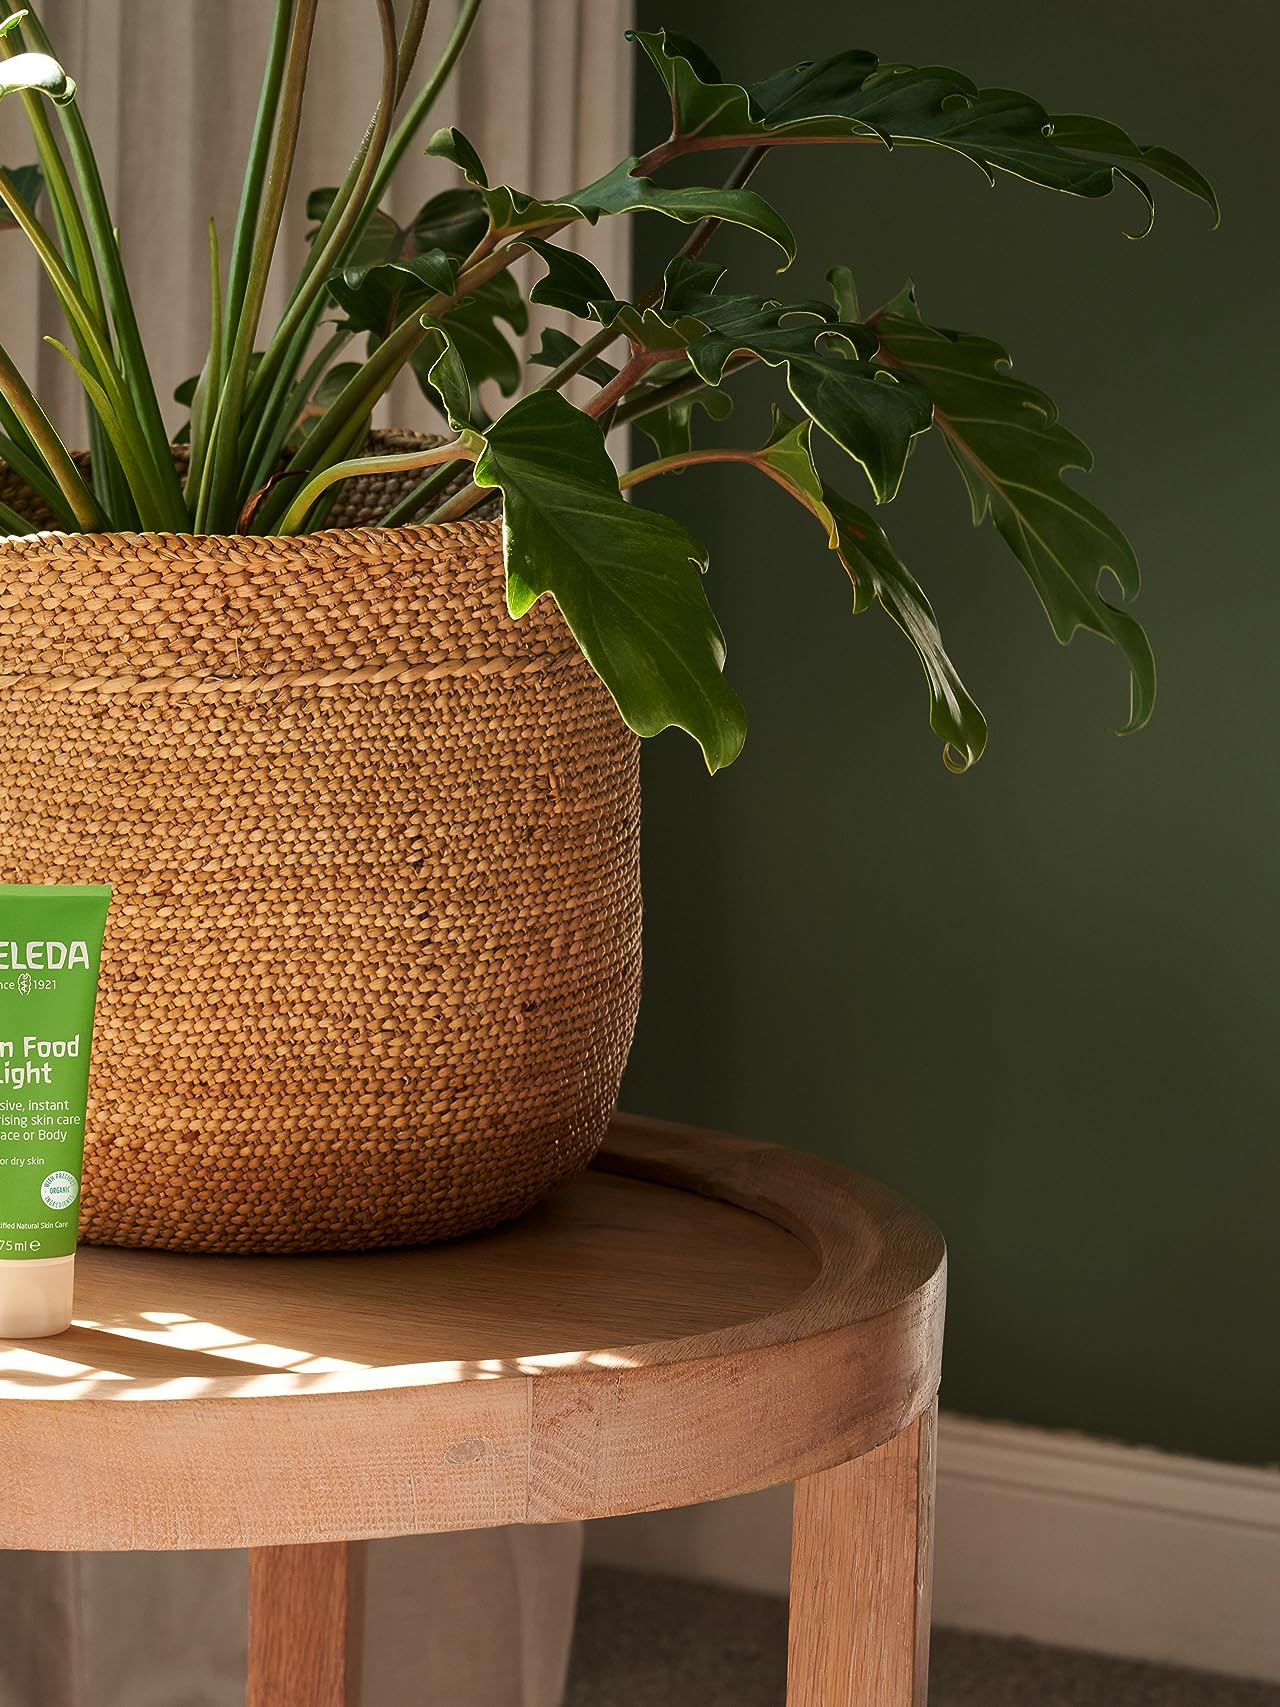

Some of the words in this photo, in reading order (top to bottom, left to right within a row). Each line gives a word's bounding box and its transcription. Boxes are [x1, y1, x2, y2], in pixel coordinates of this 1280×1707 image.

[33, 980, 56, 990] 1921
[24, 1034, 79, 1058] Food
[28, 1100, 69, 1111] instant
[32, 1115, 53, 1125] skin
[57, 1116, 80, 1125] care
[23, 1132, 34, 1140] or
[39, 1129, 67, 1142] Body
[11, 1157, 25, 1167] dry
[27, 1157, 44, 1165] skin
[41, 1221, 53, 1229] Skin
